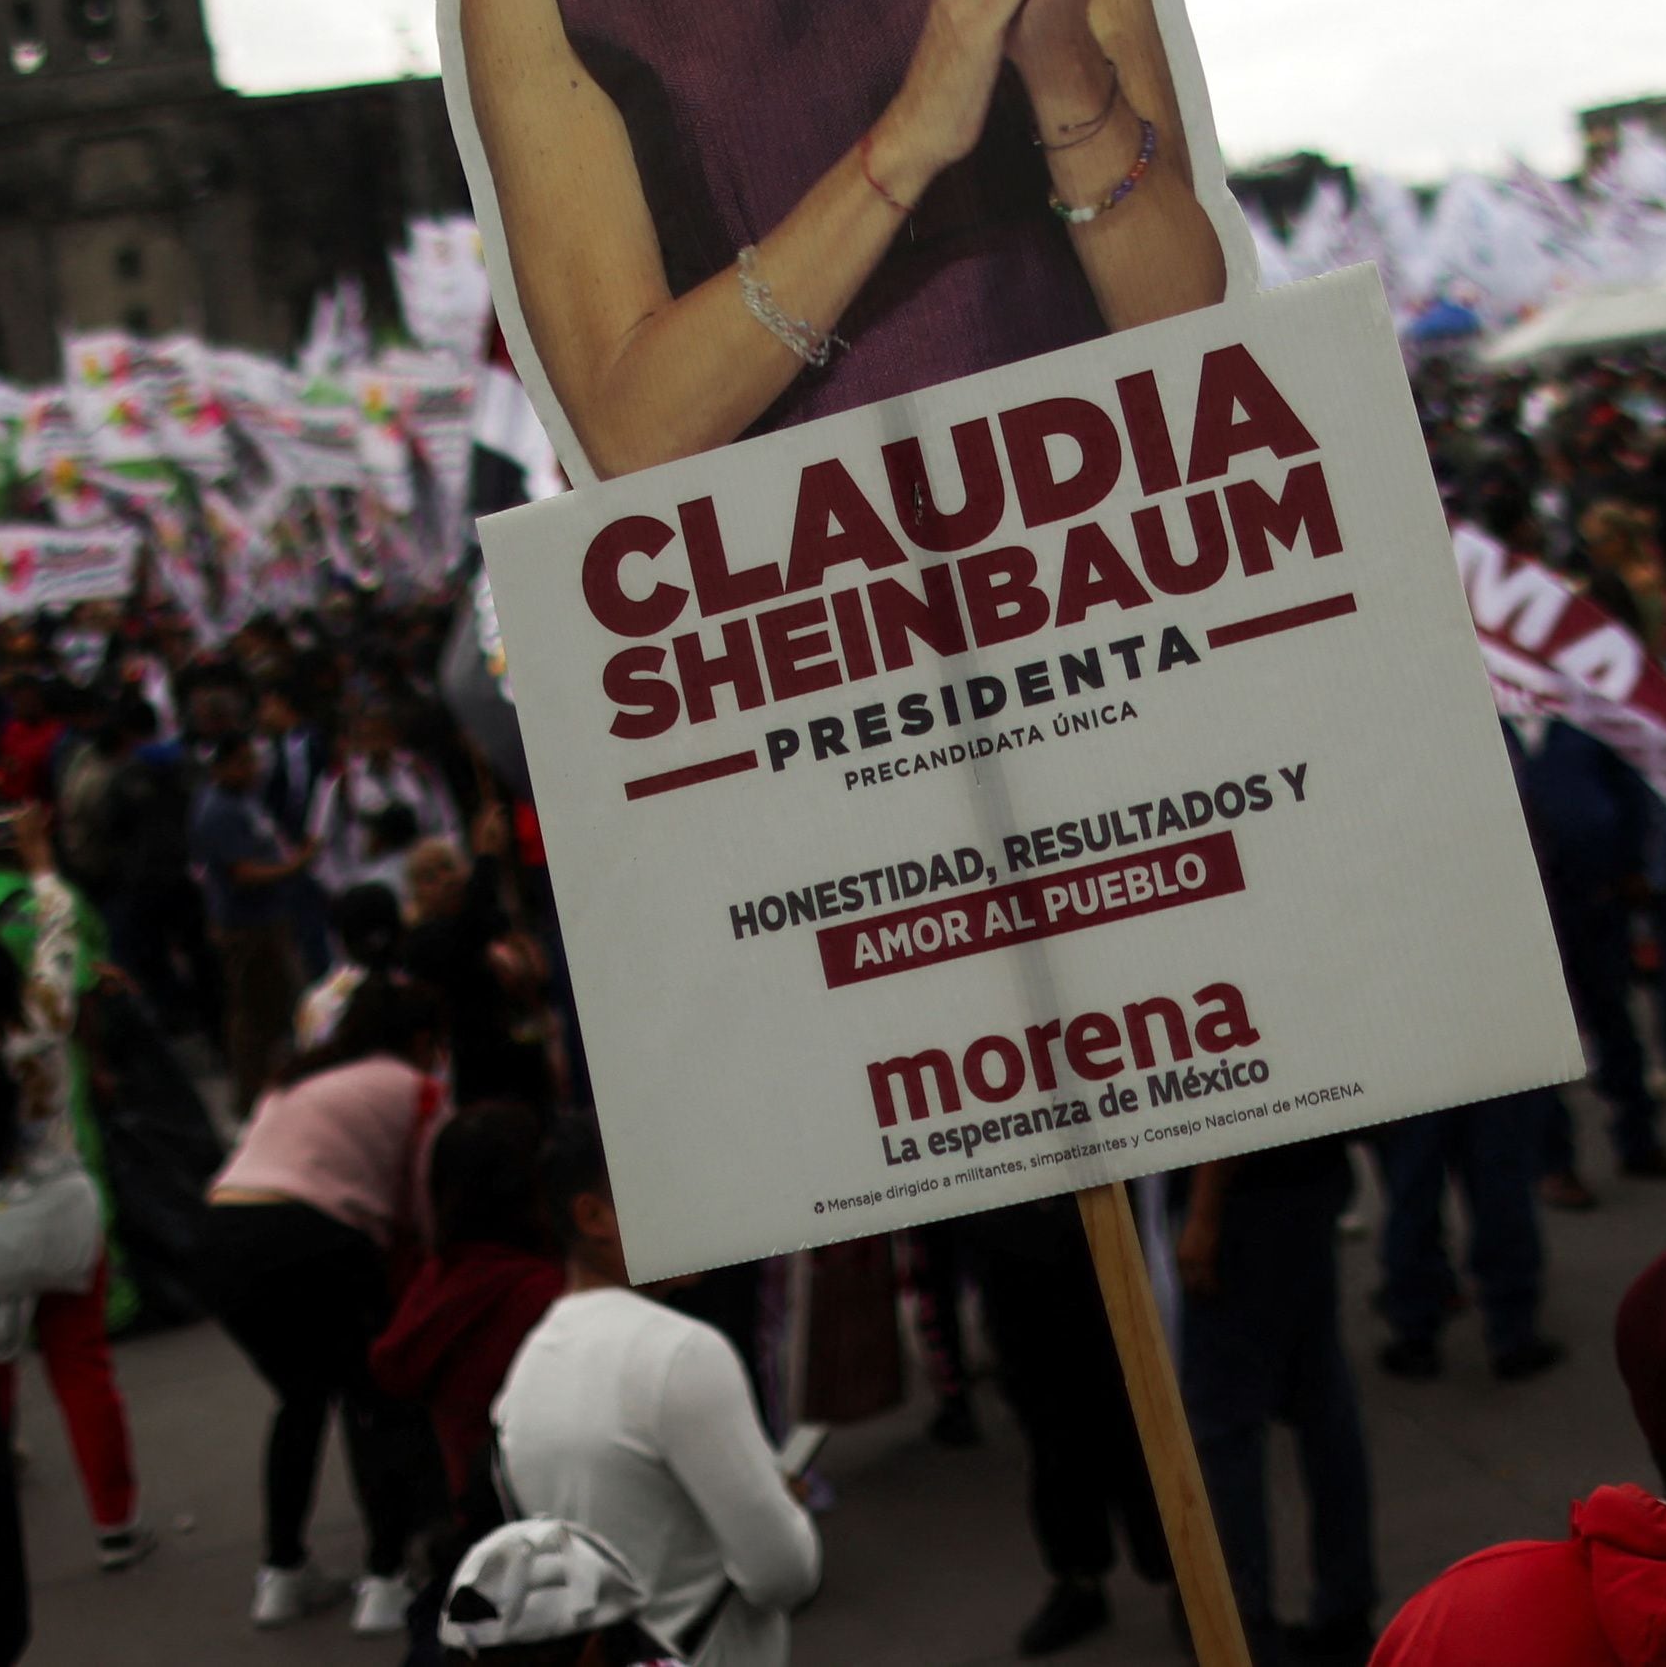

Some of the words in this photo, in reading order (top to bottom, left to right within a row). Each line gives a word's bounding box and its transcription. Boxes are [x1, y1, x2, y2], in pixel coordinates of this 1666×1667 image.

[582, 343, 1322, 638] CLAUDIA
[603, 461, 1344, 741] SHEINBAUM
[765, 625, 1202, 774] PRESIDENTA
[844, 724, 1045, 791] PRECANDIDATA
[1053, 701, 1139, 738] ÚNICA
[729, 847, 999, 941] HONESTIDAD,
[1002, 774, 1274, 875] RESULTADOS
[1278, 762, 1308, 803] Y
[854, 910, 974, 969] AMOR
[984, 896, 1036, 938] AL
[1043, 852, 1207, 924] PUEBLO
[866, 982, 1262, 1129] morena
[882, 1134, 921, 1167] La
[927, 1097, 1092, 1158] esperanza
[1099, 1082, 1139, 1118] de
[1147, 1058, 1270, 1108] México
[828, 1189, 883, 1213] Mensaje
[886, 1177, 939, 1201] dirigido
[943, 1176, 952, 1188] a
[955, 1160, 1027, 1184] militantes,
[1030, 1135, 1128, 1167] simpatizantes
[1130, 1135, 1140, 1148] y
[1144, 1119, 1202, 1144] Consejo
[1205, 1103, 1268, 1129] Nacional
[1272, 1097, 1291, 1114] de
[1295, 1082, 1364, 1108] MORENA
